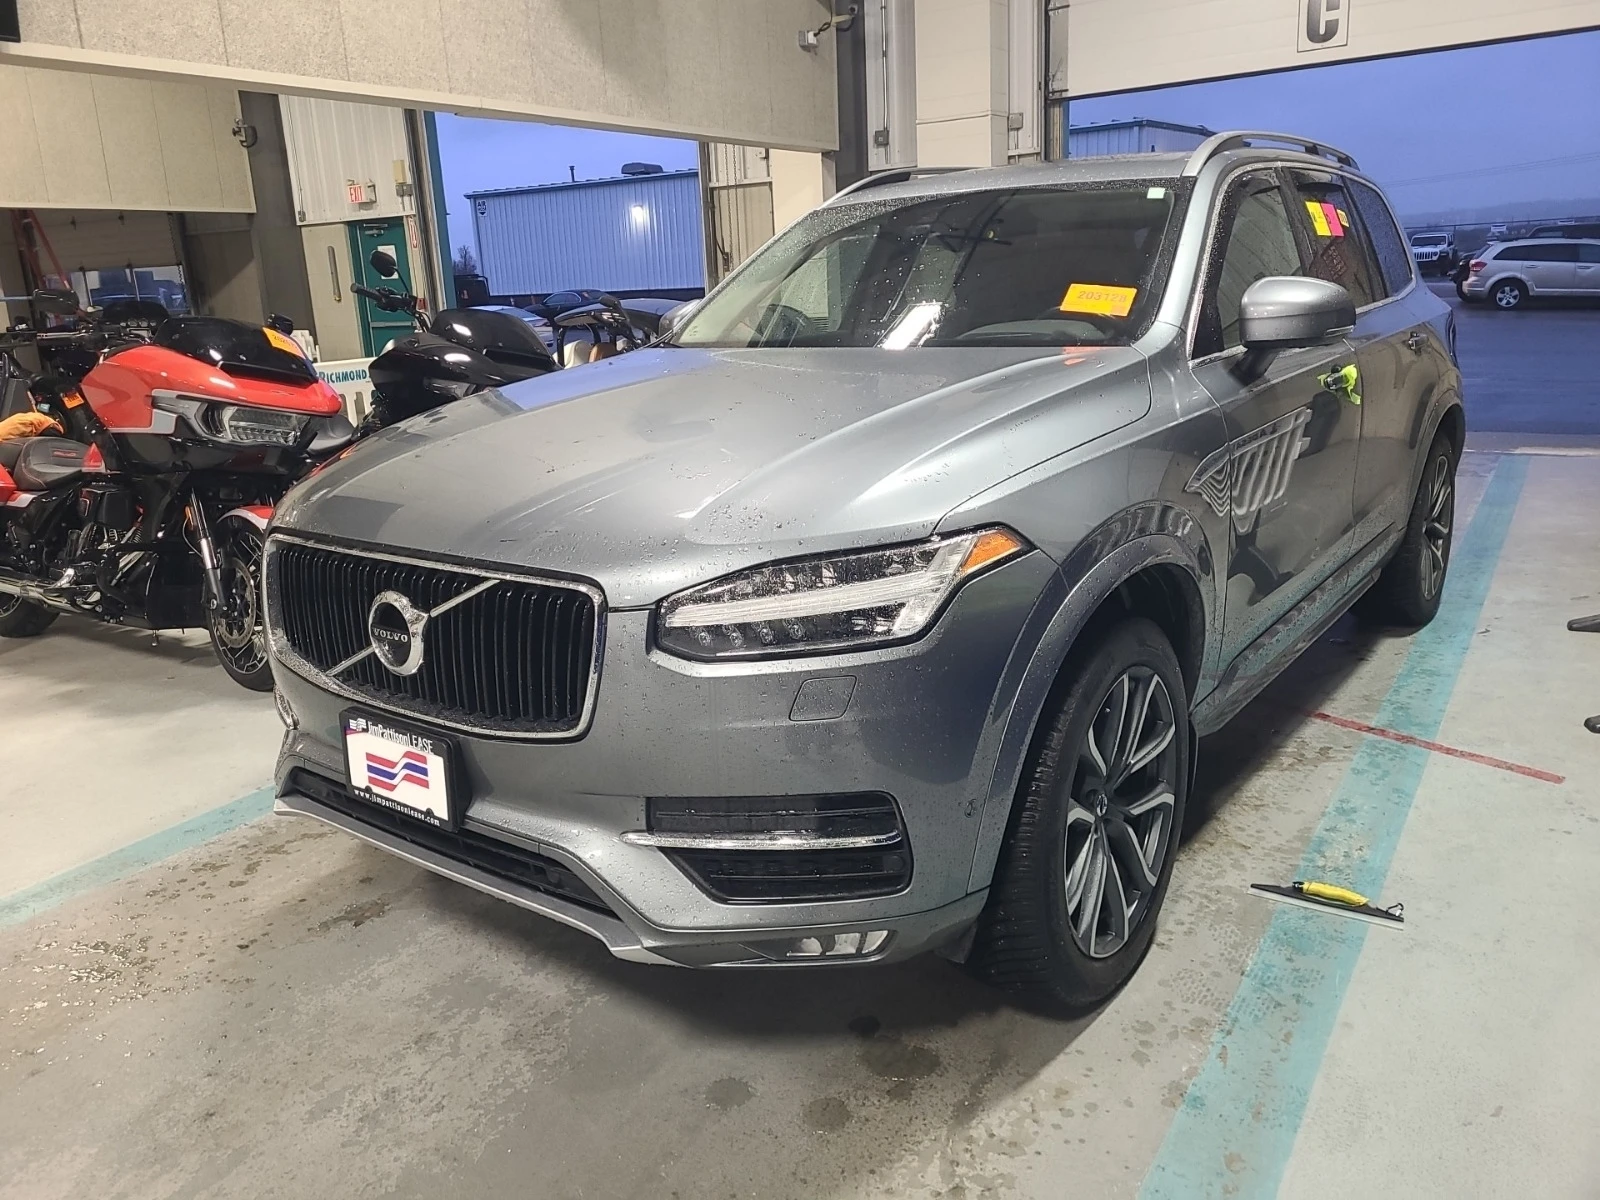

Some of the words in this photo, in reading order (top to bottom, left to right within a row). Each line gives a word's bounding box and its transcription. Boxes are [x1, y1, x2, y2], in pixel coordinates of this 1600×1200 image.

[1306, 0, 1340, 43] C
[349, 186, 363, 202] EXIT
[318, 369, 367, 383] RICHMOND
[373, 628, 408, 643] VOLVO
[353, 789, 440, 826] www.jimpattisonlease.com
